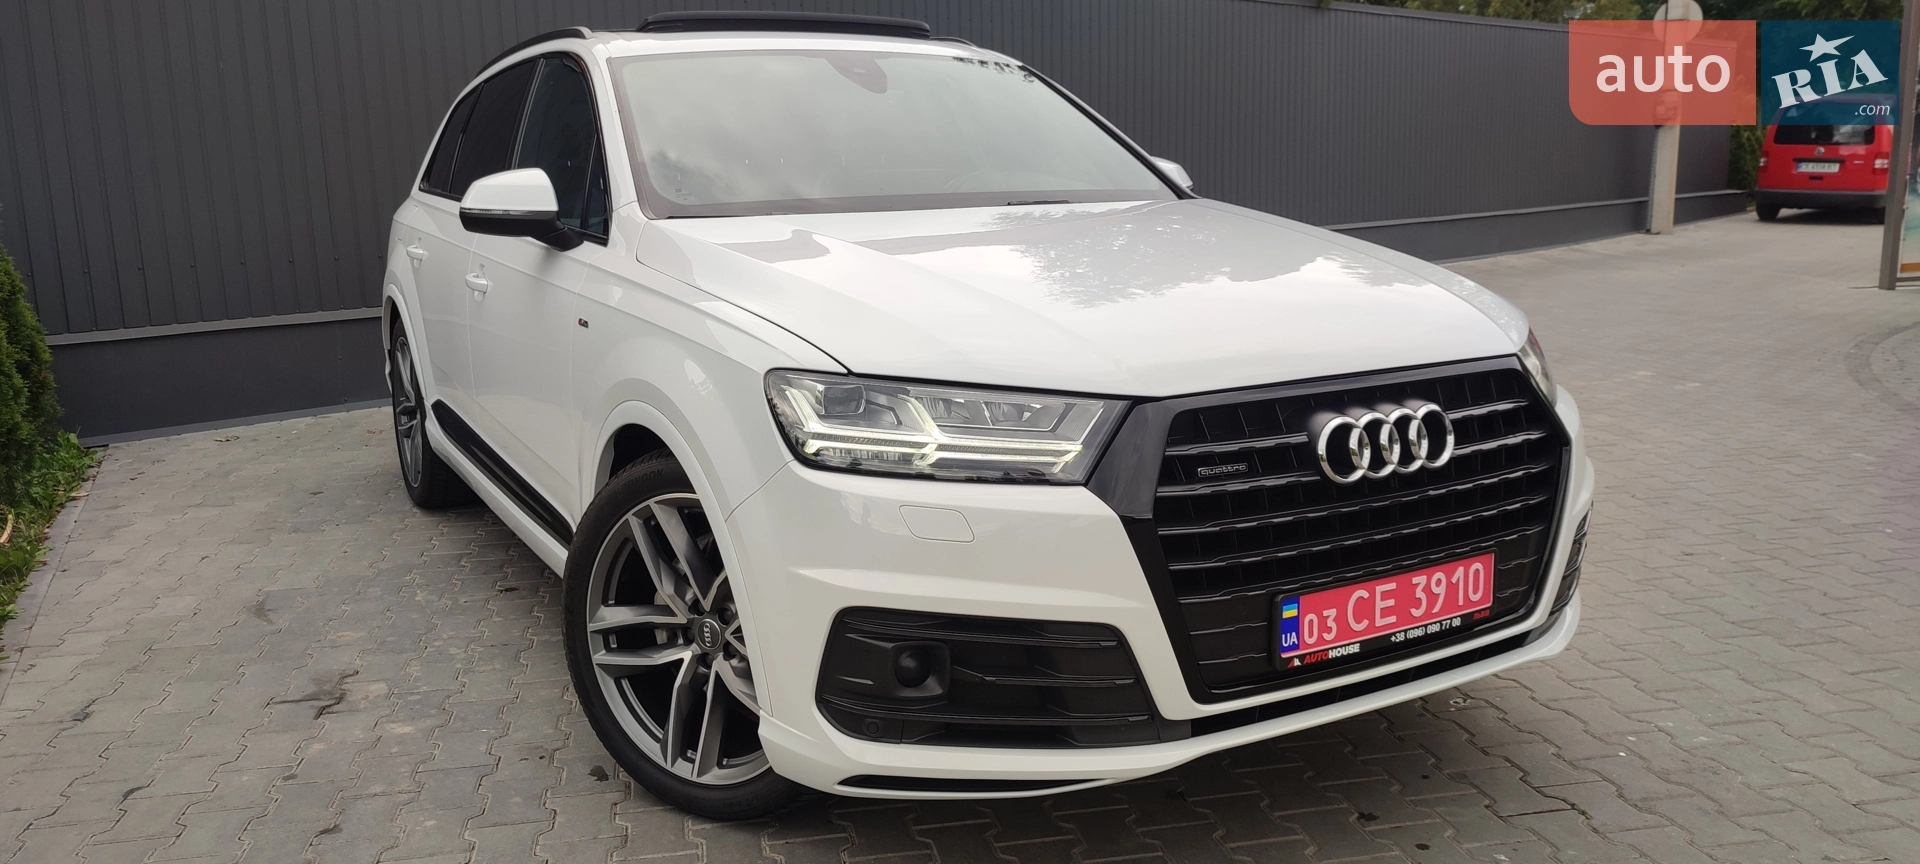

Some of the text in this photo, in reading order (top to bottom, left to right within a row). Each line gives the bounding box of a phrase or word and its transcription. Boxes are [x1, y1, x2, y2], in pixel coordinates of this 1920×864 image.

[1200, 465, 1247, 476] quattro
[1303, 562, 1485, 645] 03 CE 3910
[1282, 631, 1298, 647] UA
[1390, 617, 1462, 642] +38 (096) 090 77 00
[1304, 643, 1360, 664] AUTOHOUSE
